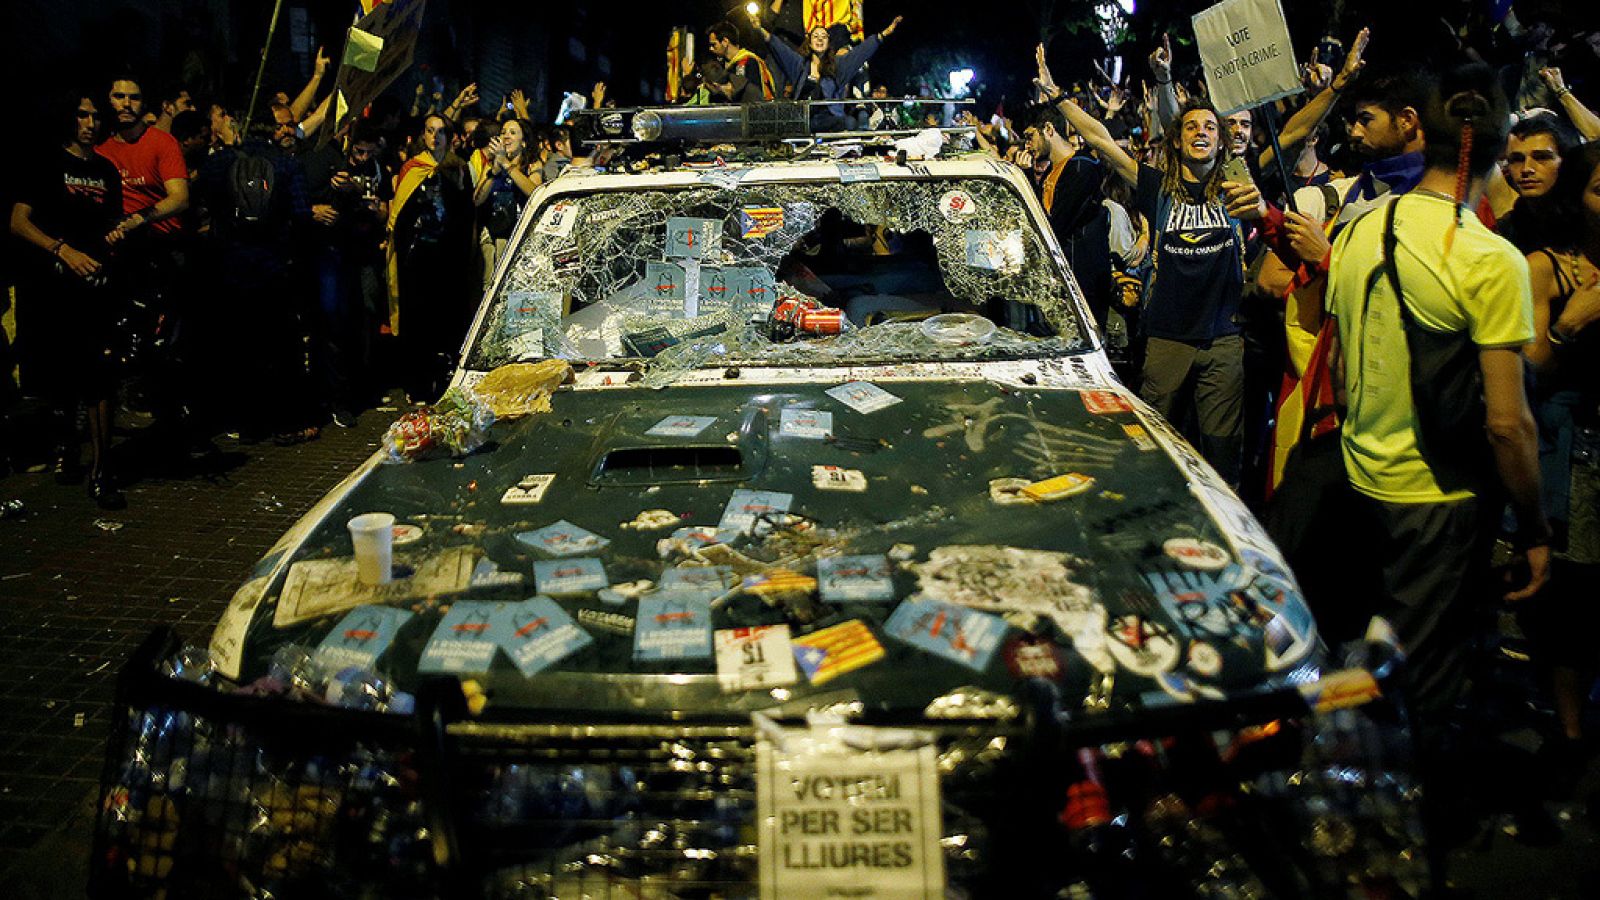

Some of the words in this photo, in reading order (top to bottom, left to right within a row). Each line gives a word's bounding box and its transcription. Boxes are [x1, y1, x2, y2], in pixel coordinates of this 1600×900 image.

[1226, 27, 1250, 47] VOTE
[1214, 66, 1222, 79] IS
[1221, 58, 1241, 76] NOT
[1241, 56, 1249, 69] A
[791, 774, 900, 801] VOTEM
[782, 809, 840, 835] PER
[852, 808, 913, 835] SER
[783, 842, 913, 869] LLIURES
